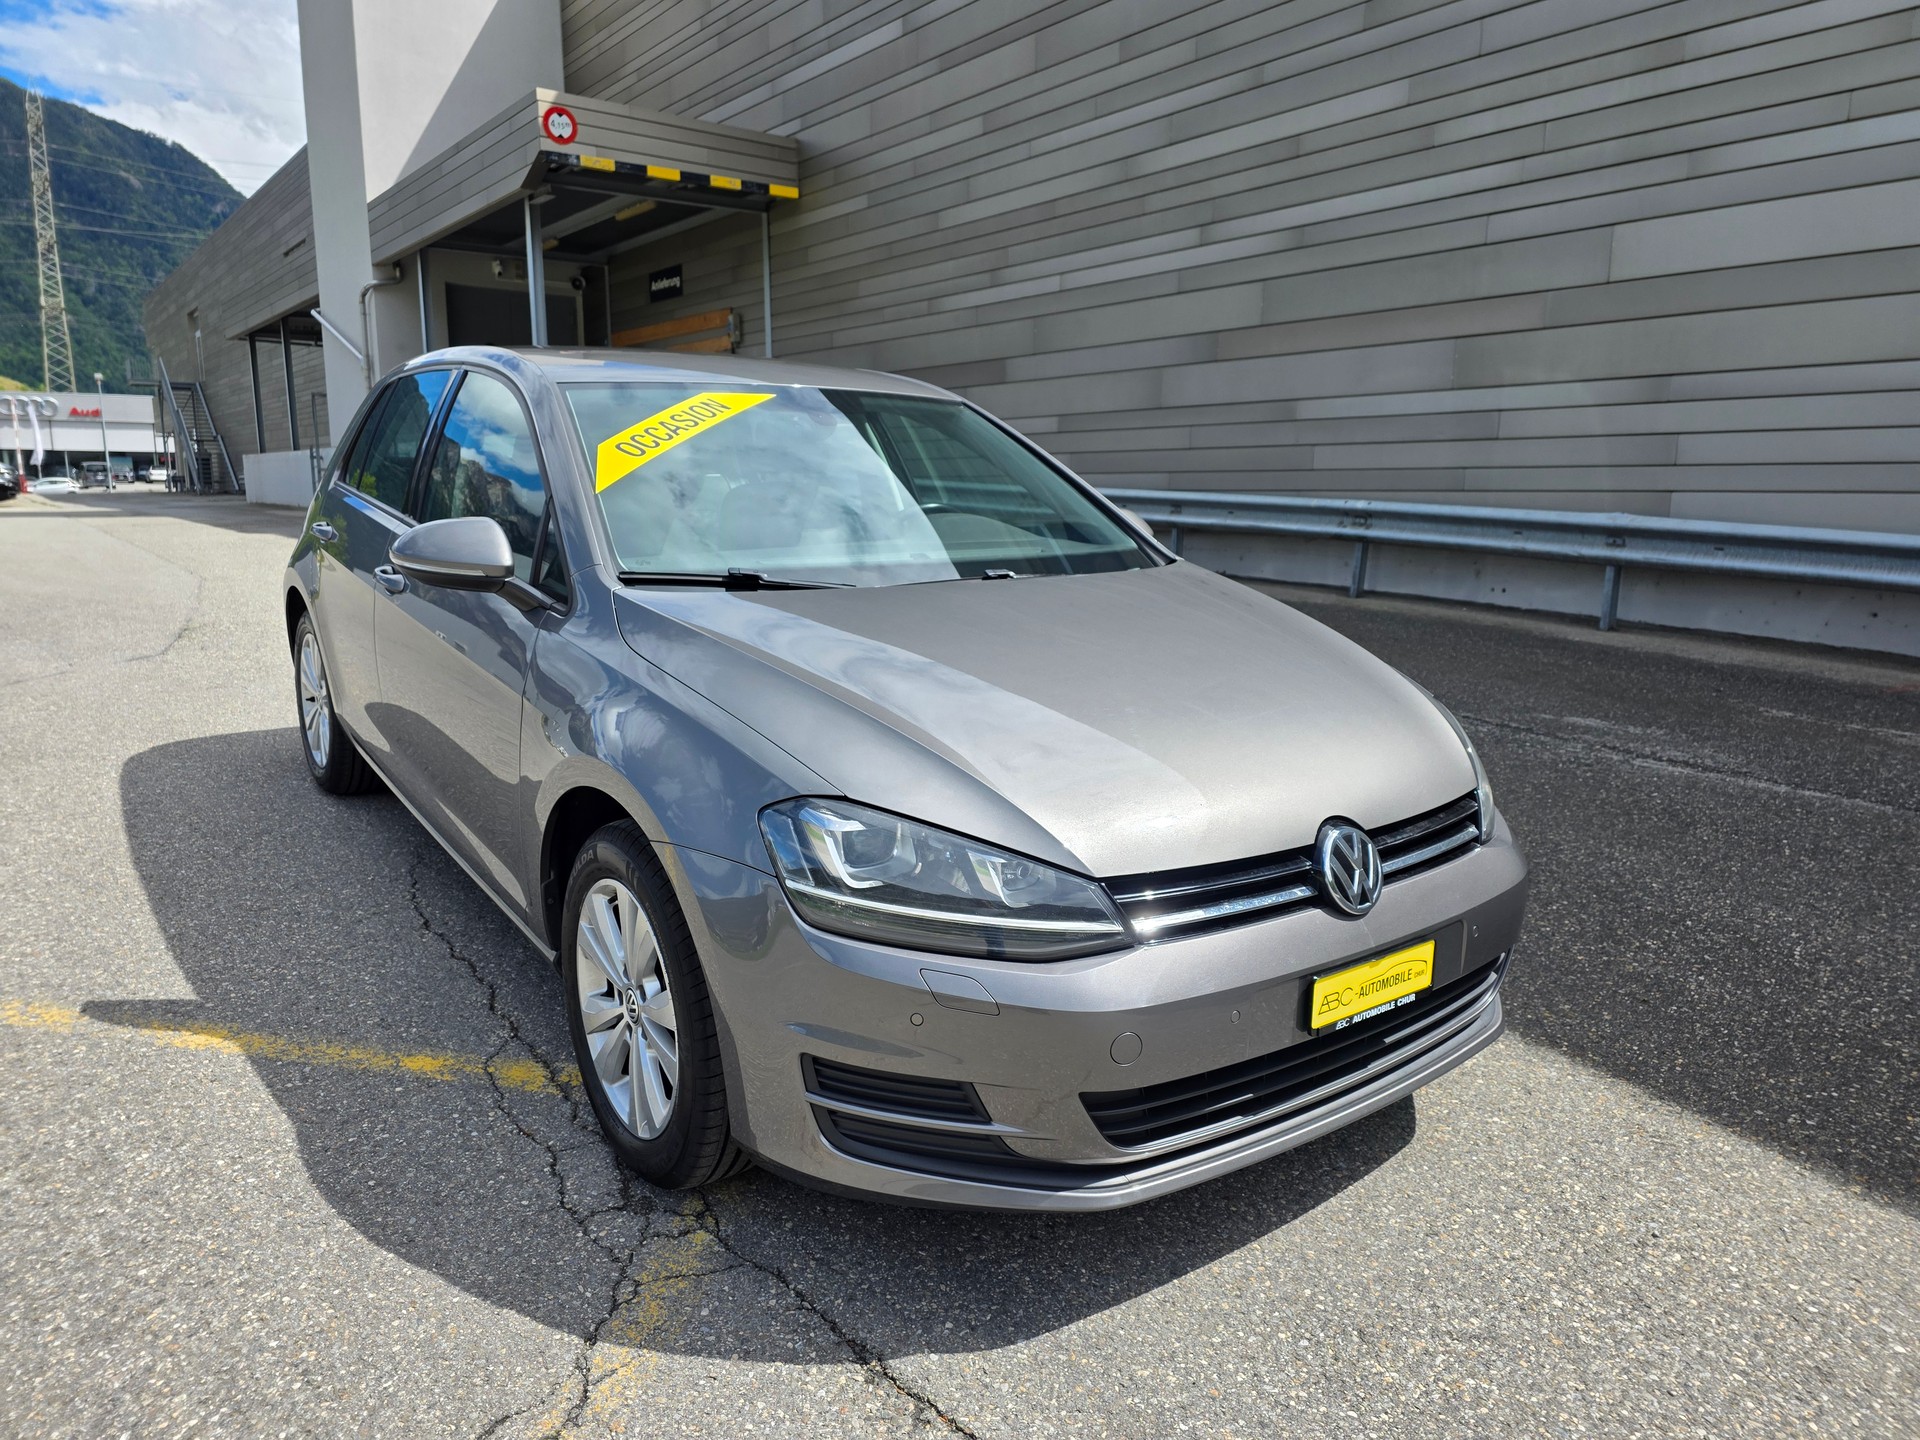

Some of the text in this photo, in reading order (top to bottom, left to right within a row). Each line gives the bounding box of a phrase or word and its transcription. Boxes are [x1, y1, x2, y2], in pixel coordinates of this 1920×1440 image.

[615, 398, 732, 457] OCCASION
[1414, 969, 1425, 979] CHUR
[1352, 1002, 1396, 1024] AUTOMOBILE
[1397, 993, 1416, 1007] CHUR
